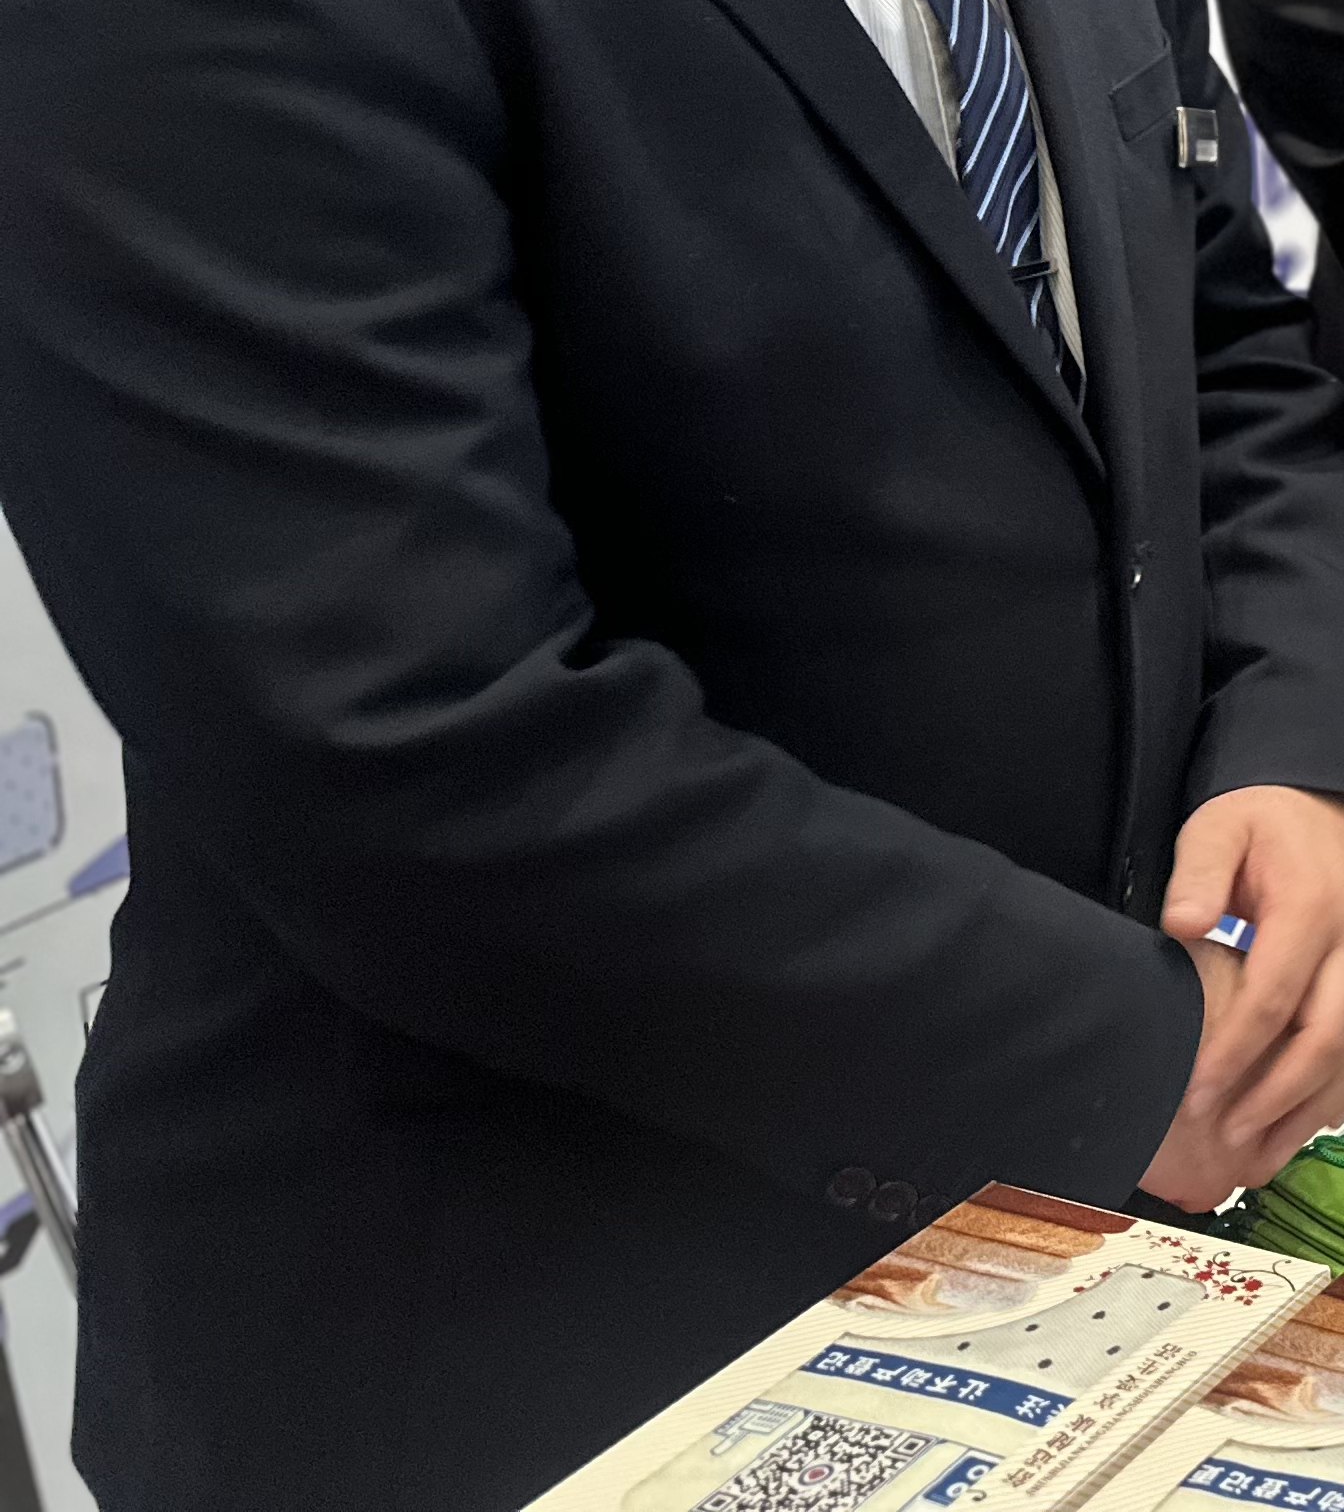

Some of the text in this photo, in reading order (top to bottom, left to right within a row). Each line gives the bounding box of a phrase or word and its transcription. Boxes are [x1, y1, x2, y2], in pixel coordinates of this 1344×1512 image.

[816, 1350, 990, 1400] 让不动产登记
